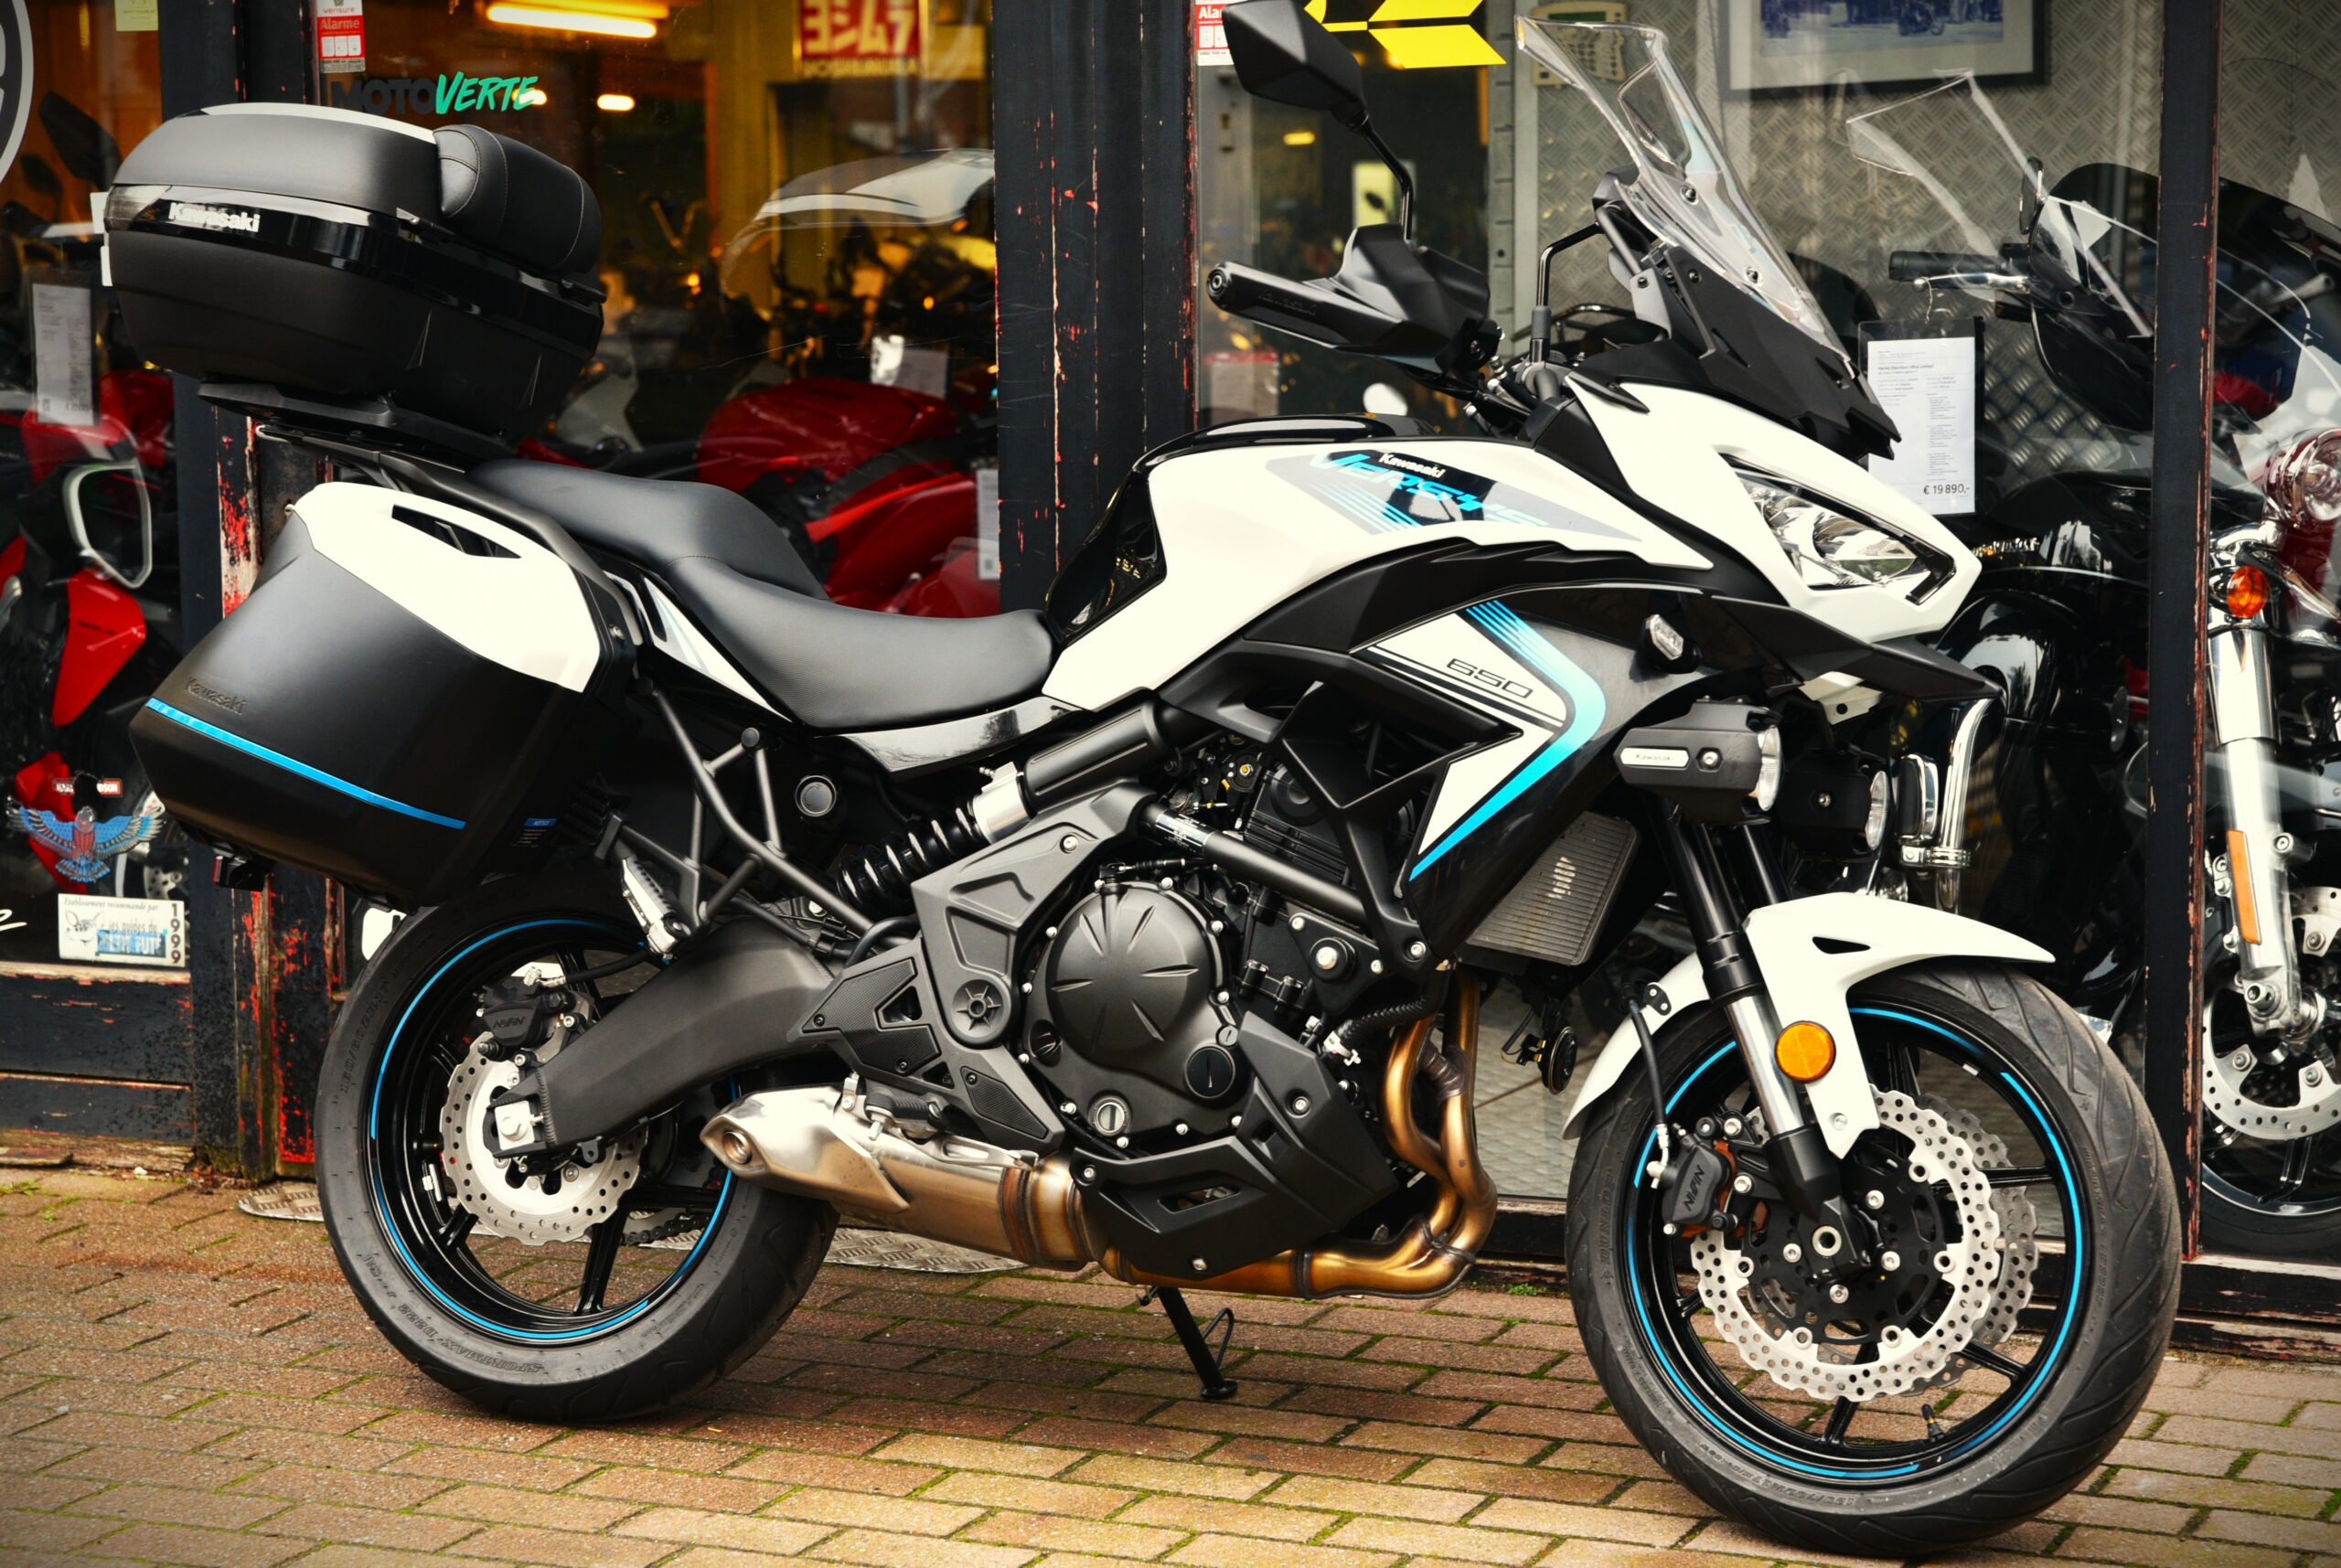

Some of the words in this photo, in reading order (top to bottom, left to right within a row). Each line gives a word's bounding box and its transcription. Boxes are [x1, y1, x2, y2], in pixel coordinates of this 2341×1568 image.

[321, 18, 359, 29] Alarme
[168, 202, 261, 232] Kawasaki
[1378, 452, 1446, 479] Kawasaki
[1309, 452, 1550, 527] VERSYS
[1447, 658, 1534, 699] 650
[185, 677, 248, 715] Kawasaki
